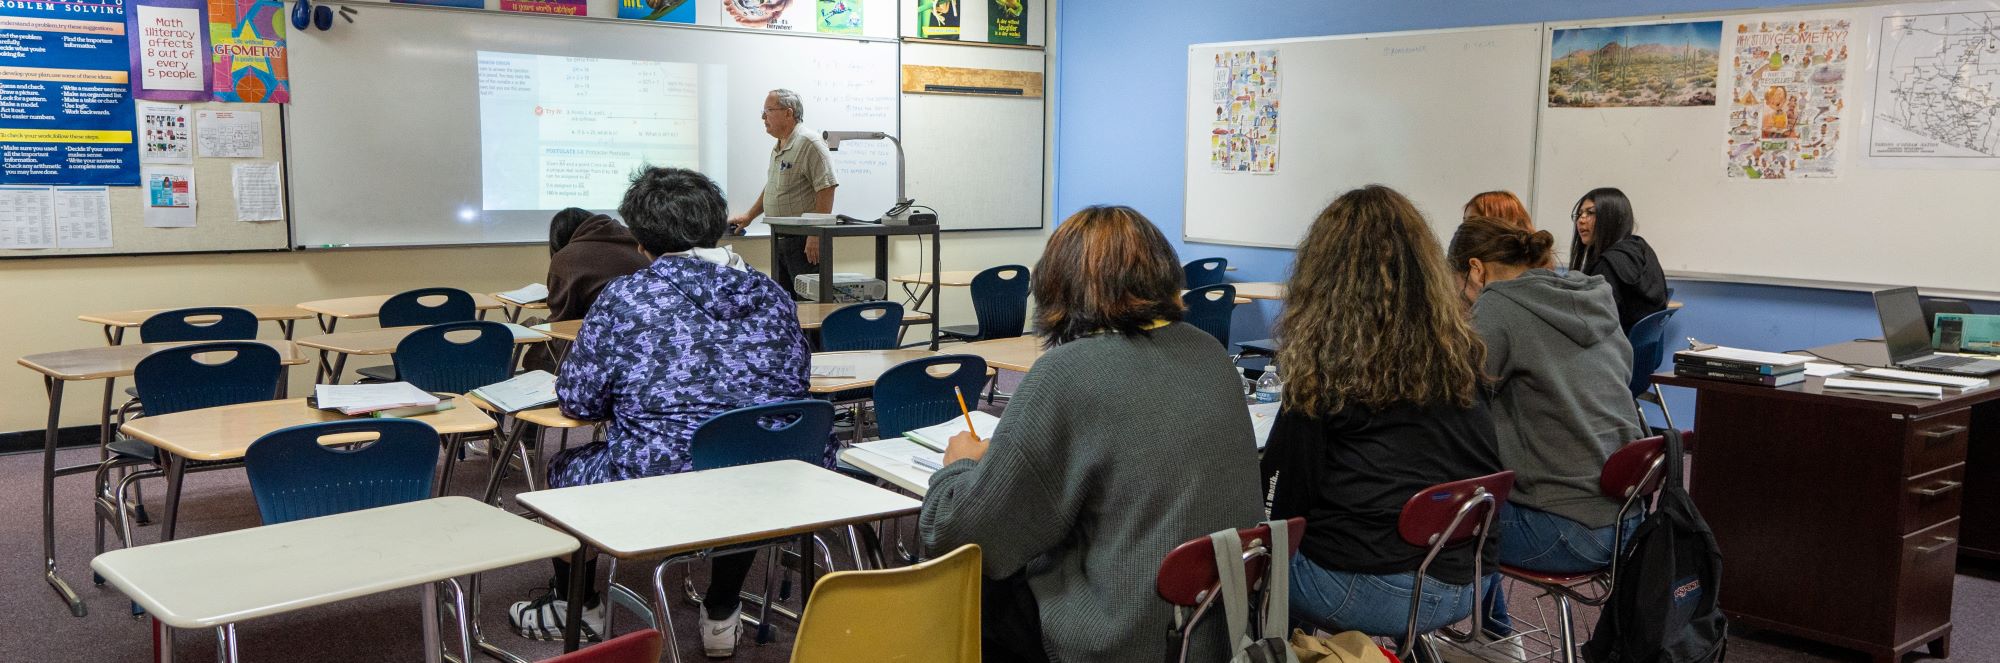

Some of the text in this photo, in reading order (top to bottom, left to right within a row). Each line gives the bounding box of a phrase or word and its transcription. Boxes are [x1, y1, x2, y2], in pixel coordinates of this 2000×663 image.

[65, 4, 124, 15] SOLVING
[156, 18, 183, 28] Math
[145, 28, 195, 40] illiteracy
[1774, 31, 1848, 45] GEOMETRY?
[148, 39, 193, 48] affects
[148, 48, 194, 58] 8 out of
[214, 44, 282, 58] GEOMETRY
[156, 60, 189, 70] every
[148, 69, 197, 79] 5 people.
